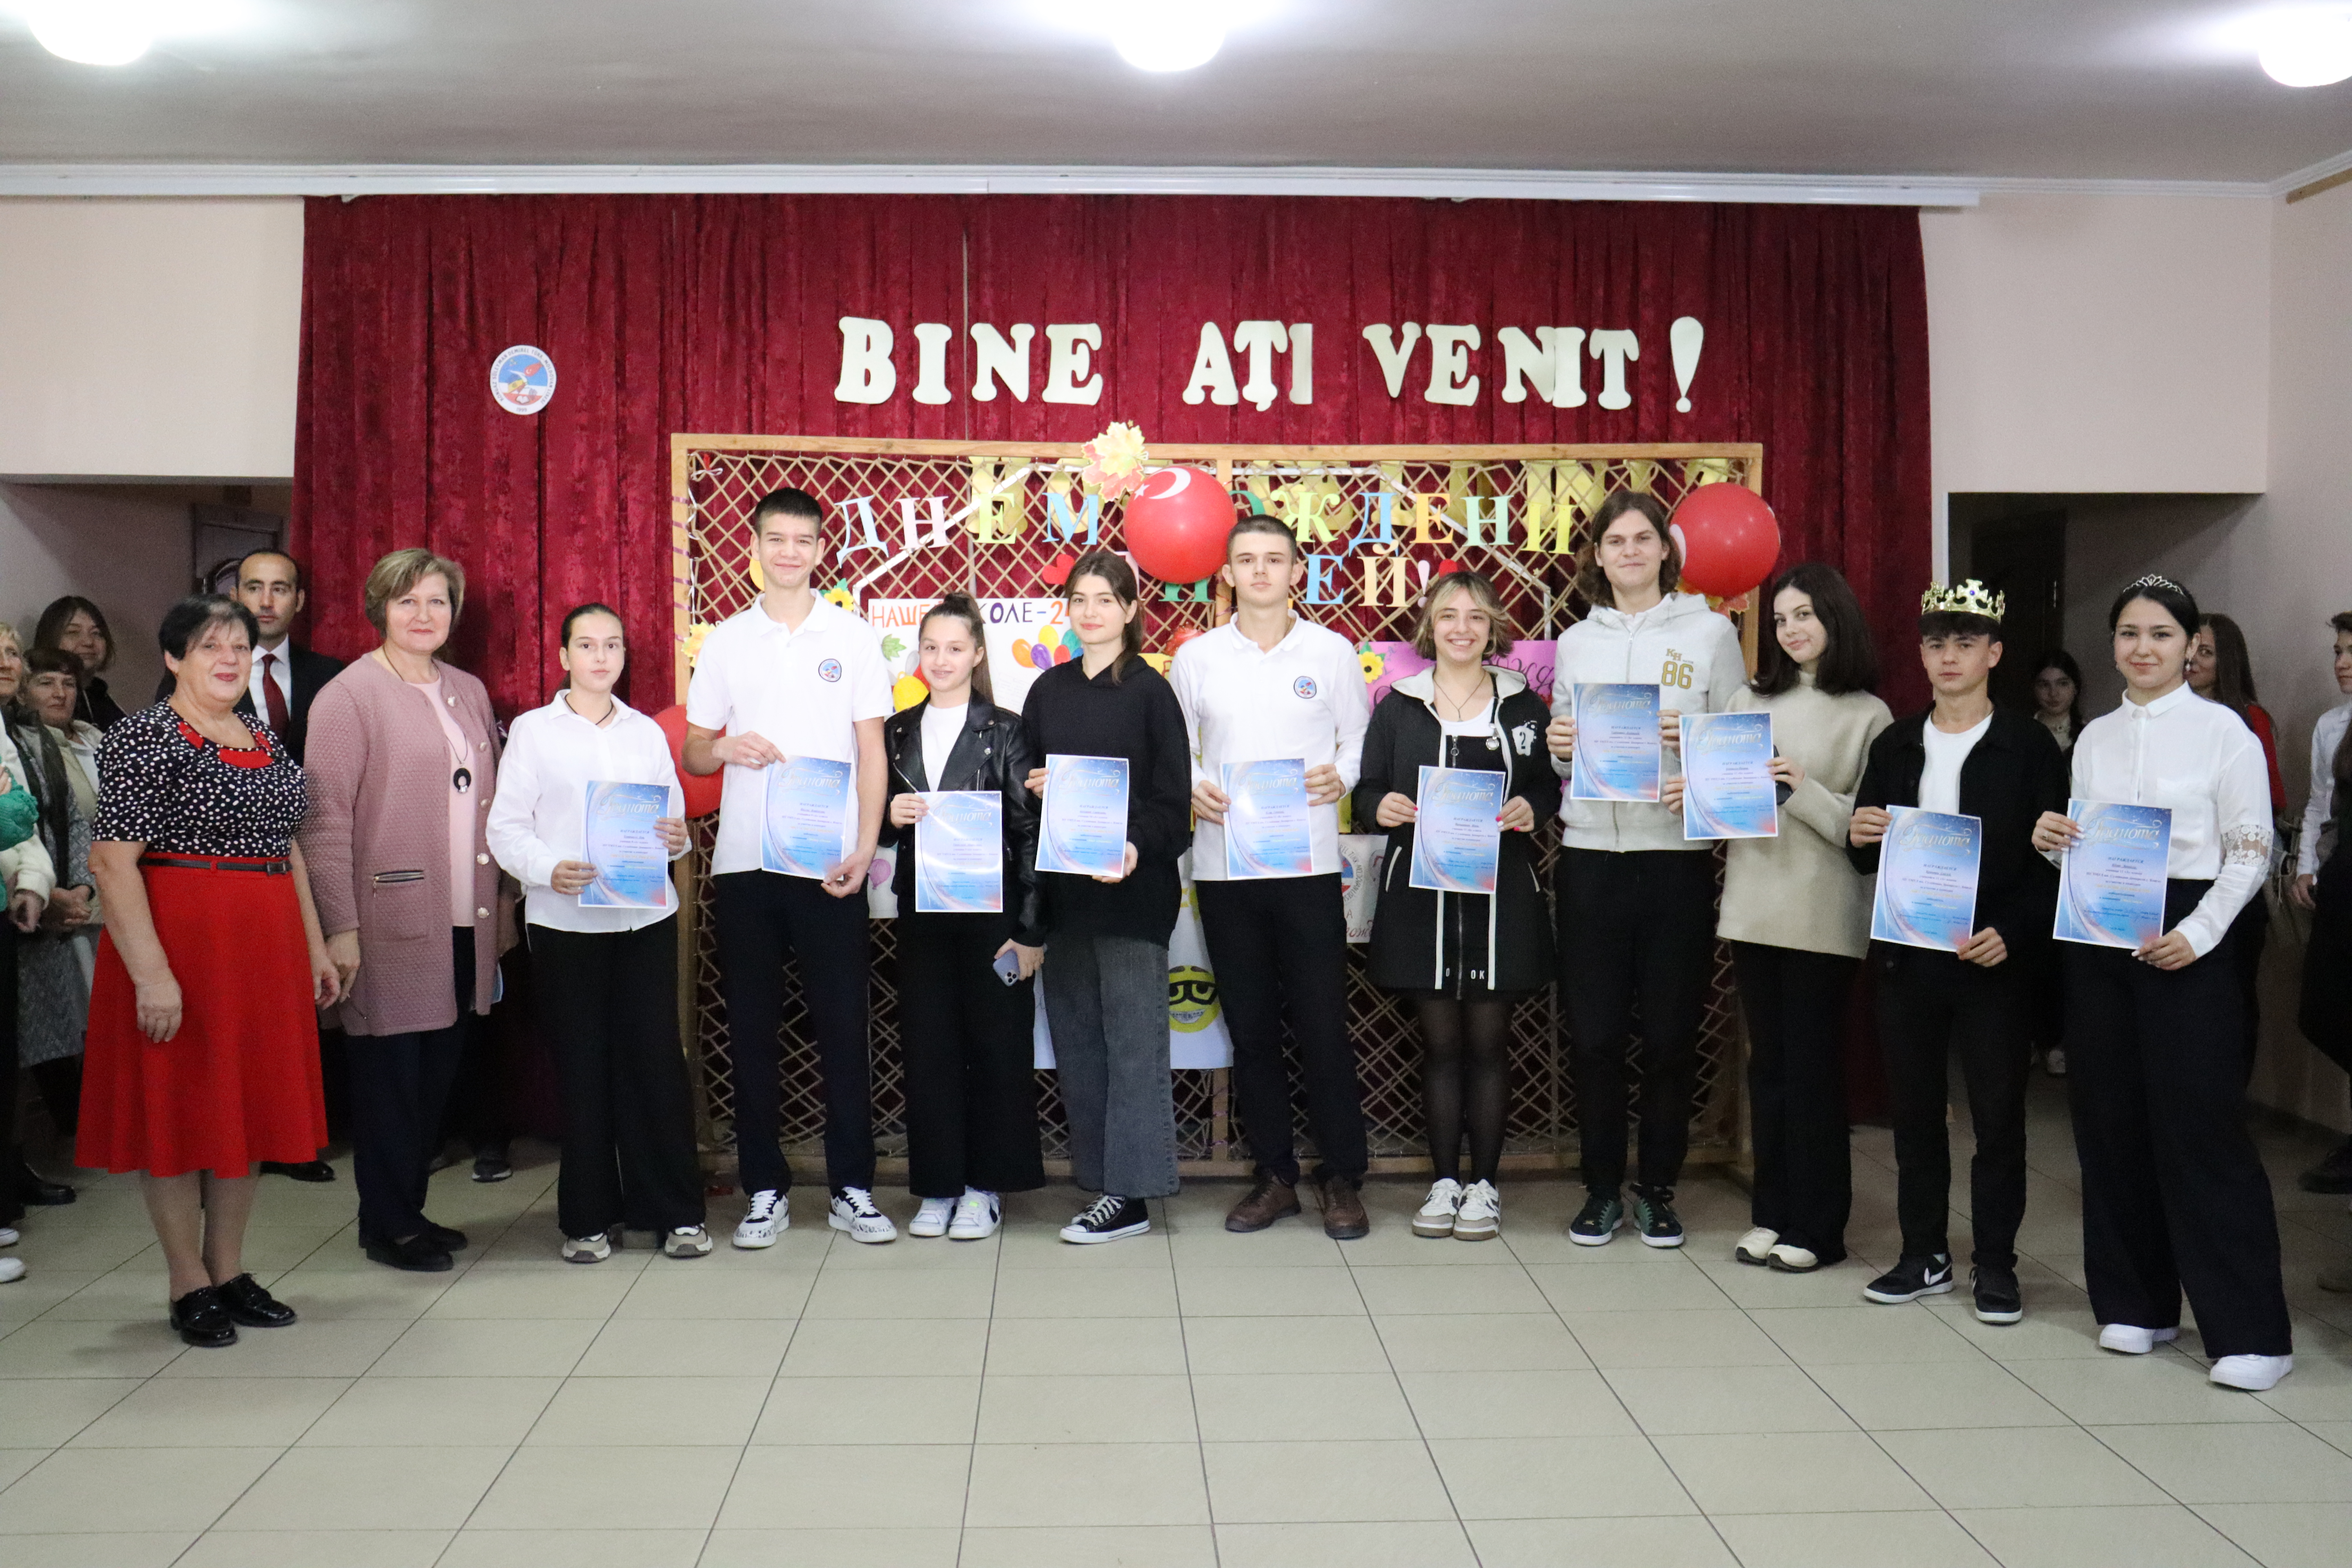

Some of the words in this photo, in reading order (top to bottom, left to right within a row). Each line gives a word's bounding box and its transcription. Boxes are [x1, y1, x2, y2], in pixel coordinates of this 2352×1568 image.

[834, 316, 1103, 405] BINE
[834, 493, 1098, 568] ДНЕМ
[872, 601, 943, 628] НАШЕ
[1661, 661, 1693, 690] 86
